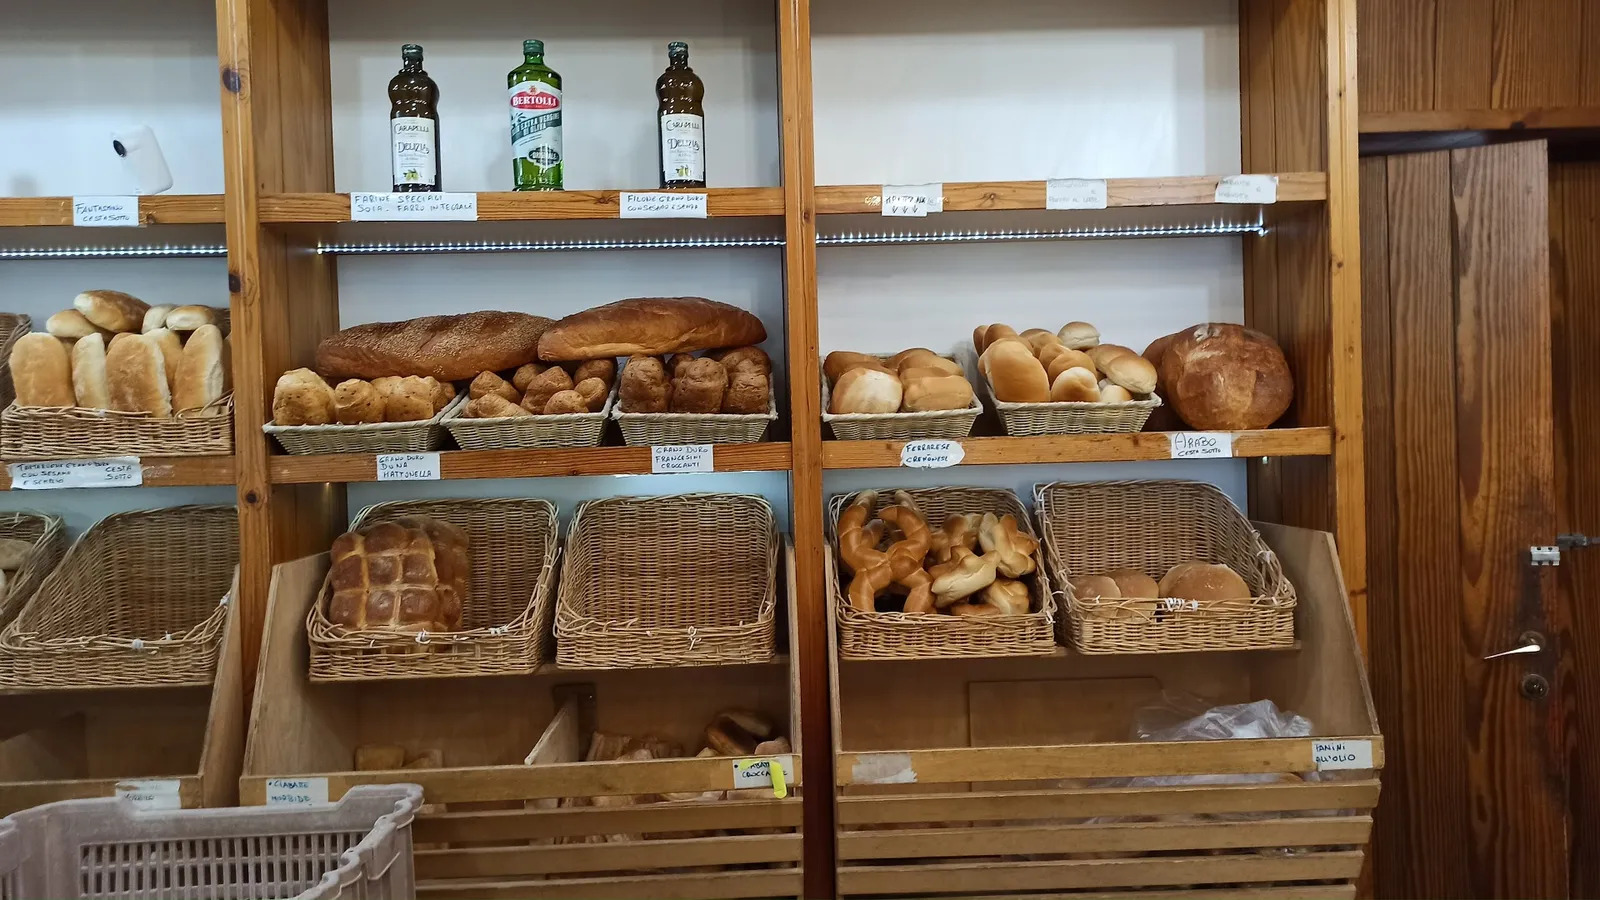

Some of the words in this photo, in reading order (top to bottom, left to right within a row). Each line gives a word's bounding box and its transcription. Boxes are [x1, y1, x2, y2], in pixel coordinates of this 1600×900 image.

[512, 95, 557, 107] BERTOLLI
[521, 117, 538, 131] EXTRA
[538, 112, 560, 124] VERGINE
[665, 119, 699, 131] CARAPELLI
[393, 122, 429, 134] CARAPELLI
[530, 122, 547, 136] OLIVA
[354, 194, 390, 203] FARINE
[397, 194, 442, 204] SPECIALI
[627, 194, 657, 203] FILONE
[658, 195, 684, 203] GRANO
[397, 203, 425, 212] FARRO
[1174, 432, 1216, 450] ARABO
[655, 446, 683, 454] GRANO
[686, 445, 709, 454] DURO
[905, 443, 950, 453] FERRARESE
[379, 455, 404, 464] GRANO
[655, 454, 701, 463] FRANCESINI
[905, 455, 948, 463] CREMONESE
[105, 465, 132, 473] CESTA
[273, 780, 309, 789] CIABATTE
[271, 794, 311, 803] MORBIDE
